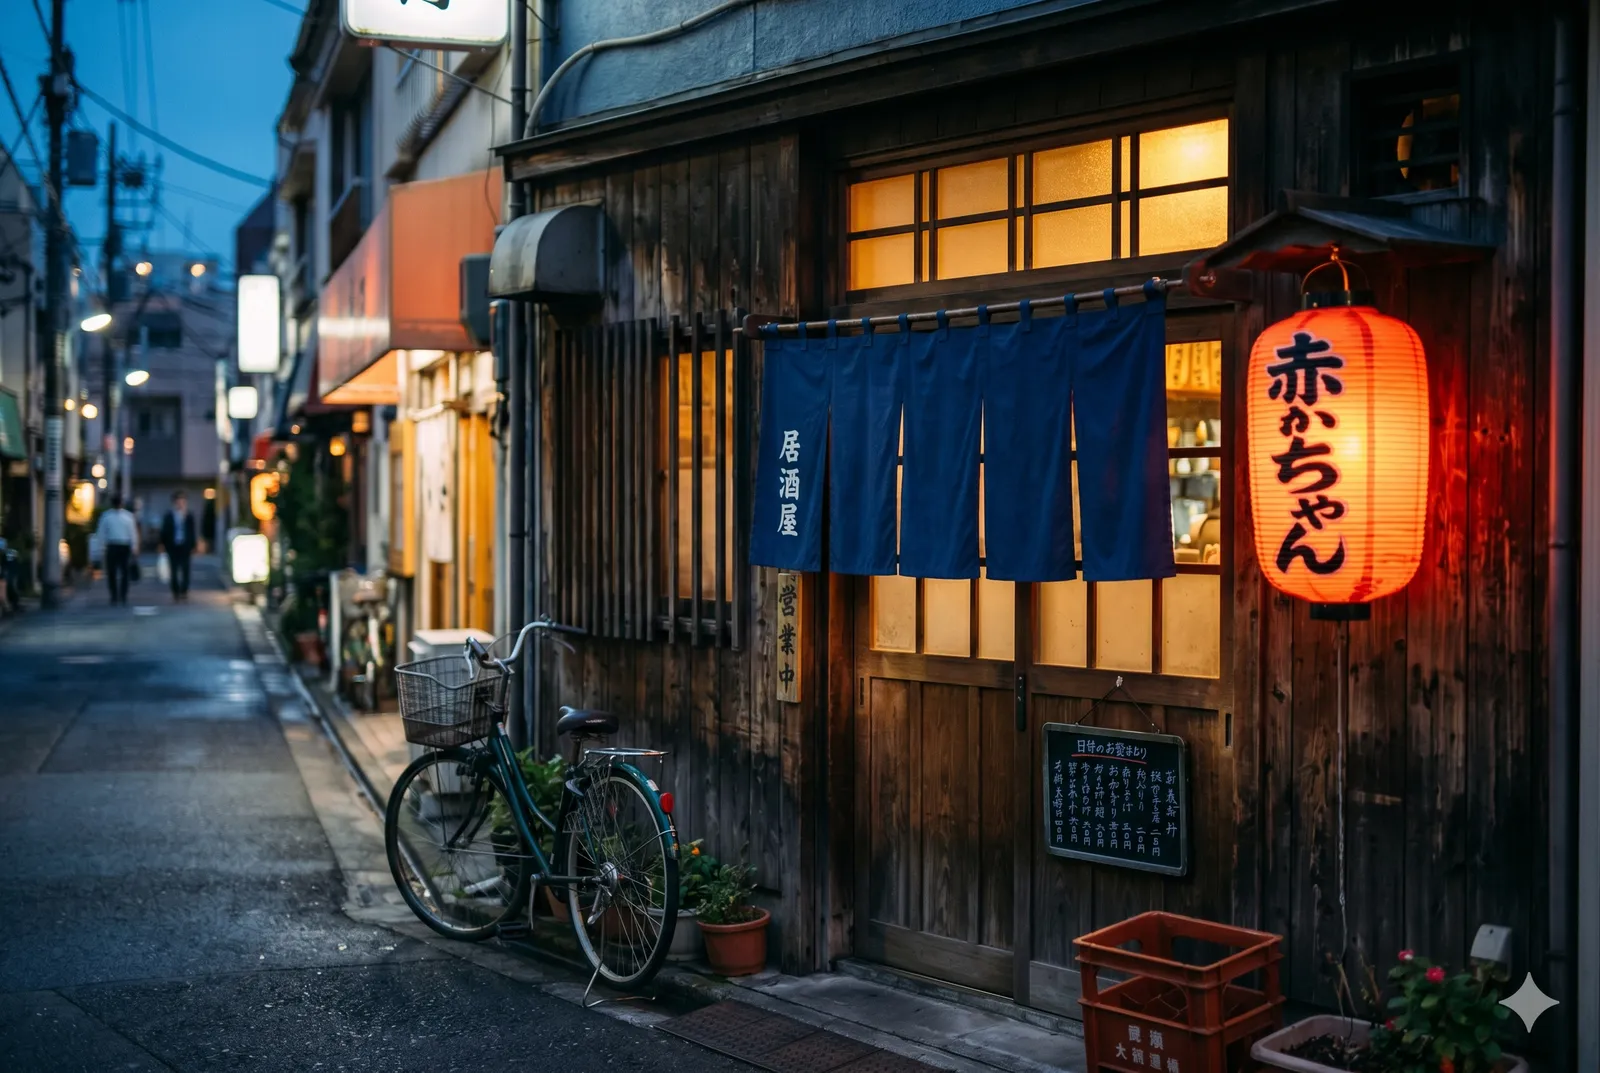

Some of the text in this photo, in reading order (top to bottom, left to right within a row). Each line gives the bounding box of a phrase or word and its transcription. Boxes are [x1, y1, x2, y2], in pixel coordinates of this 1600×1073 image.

[777, 430, 801, 537] 居酒屋
[1267, 332, 1344, 575] 赤かちゃん
[778, 584, 796, 693] 営業中
